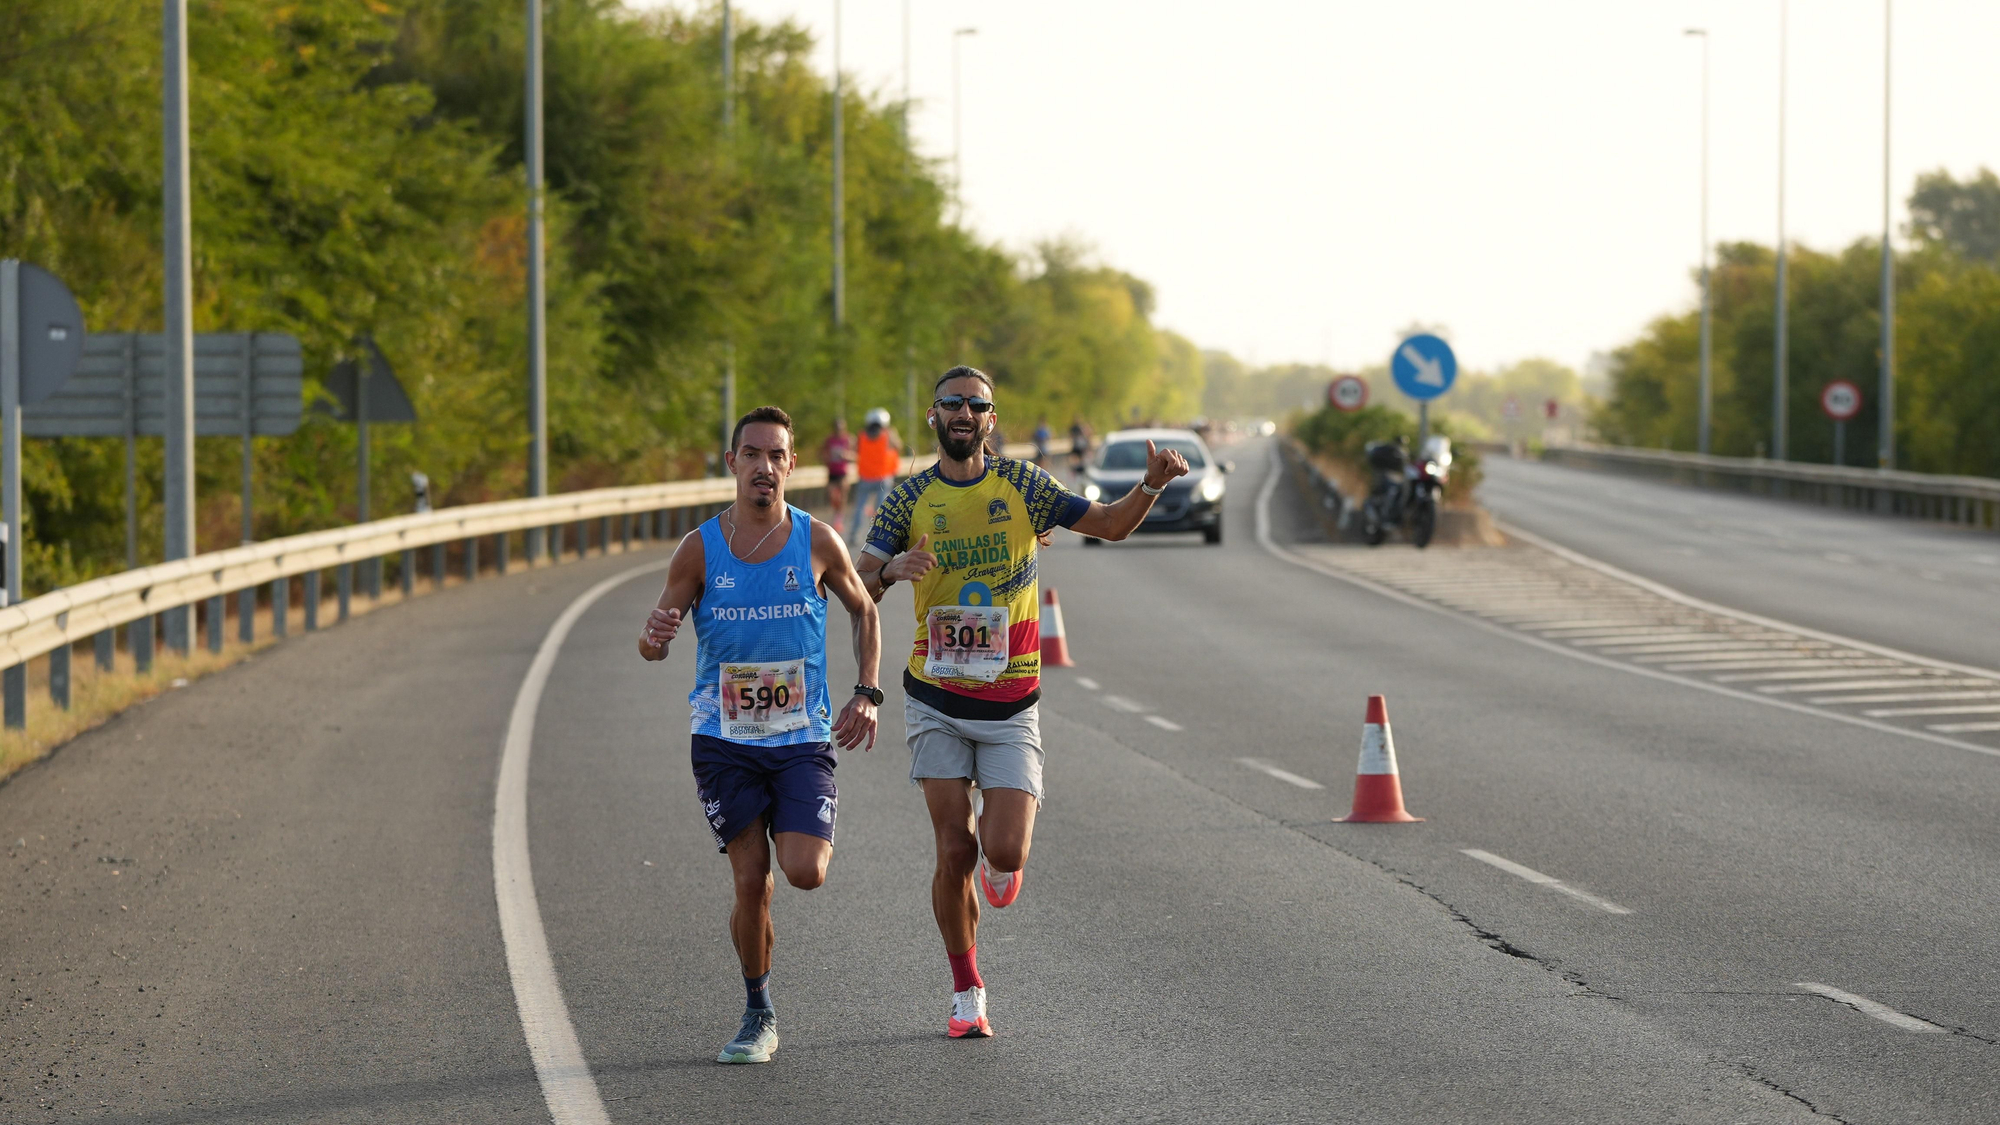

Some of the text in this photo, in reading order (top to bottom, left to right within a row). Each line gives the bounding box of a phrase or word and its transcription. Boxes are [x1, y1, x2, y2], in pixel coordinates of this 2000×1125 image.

[934, 531, 1007, 553] CANILLAS DE
[935, 546, 1011, 569] ALBAIDA
[711, 602, 811, 621] TROTASIERRA
[944, 625, 990, 648] 301
[740, 685, 789, 710] 590
